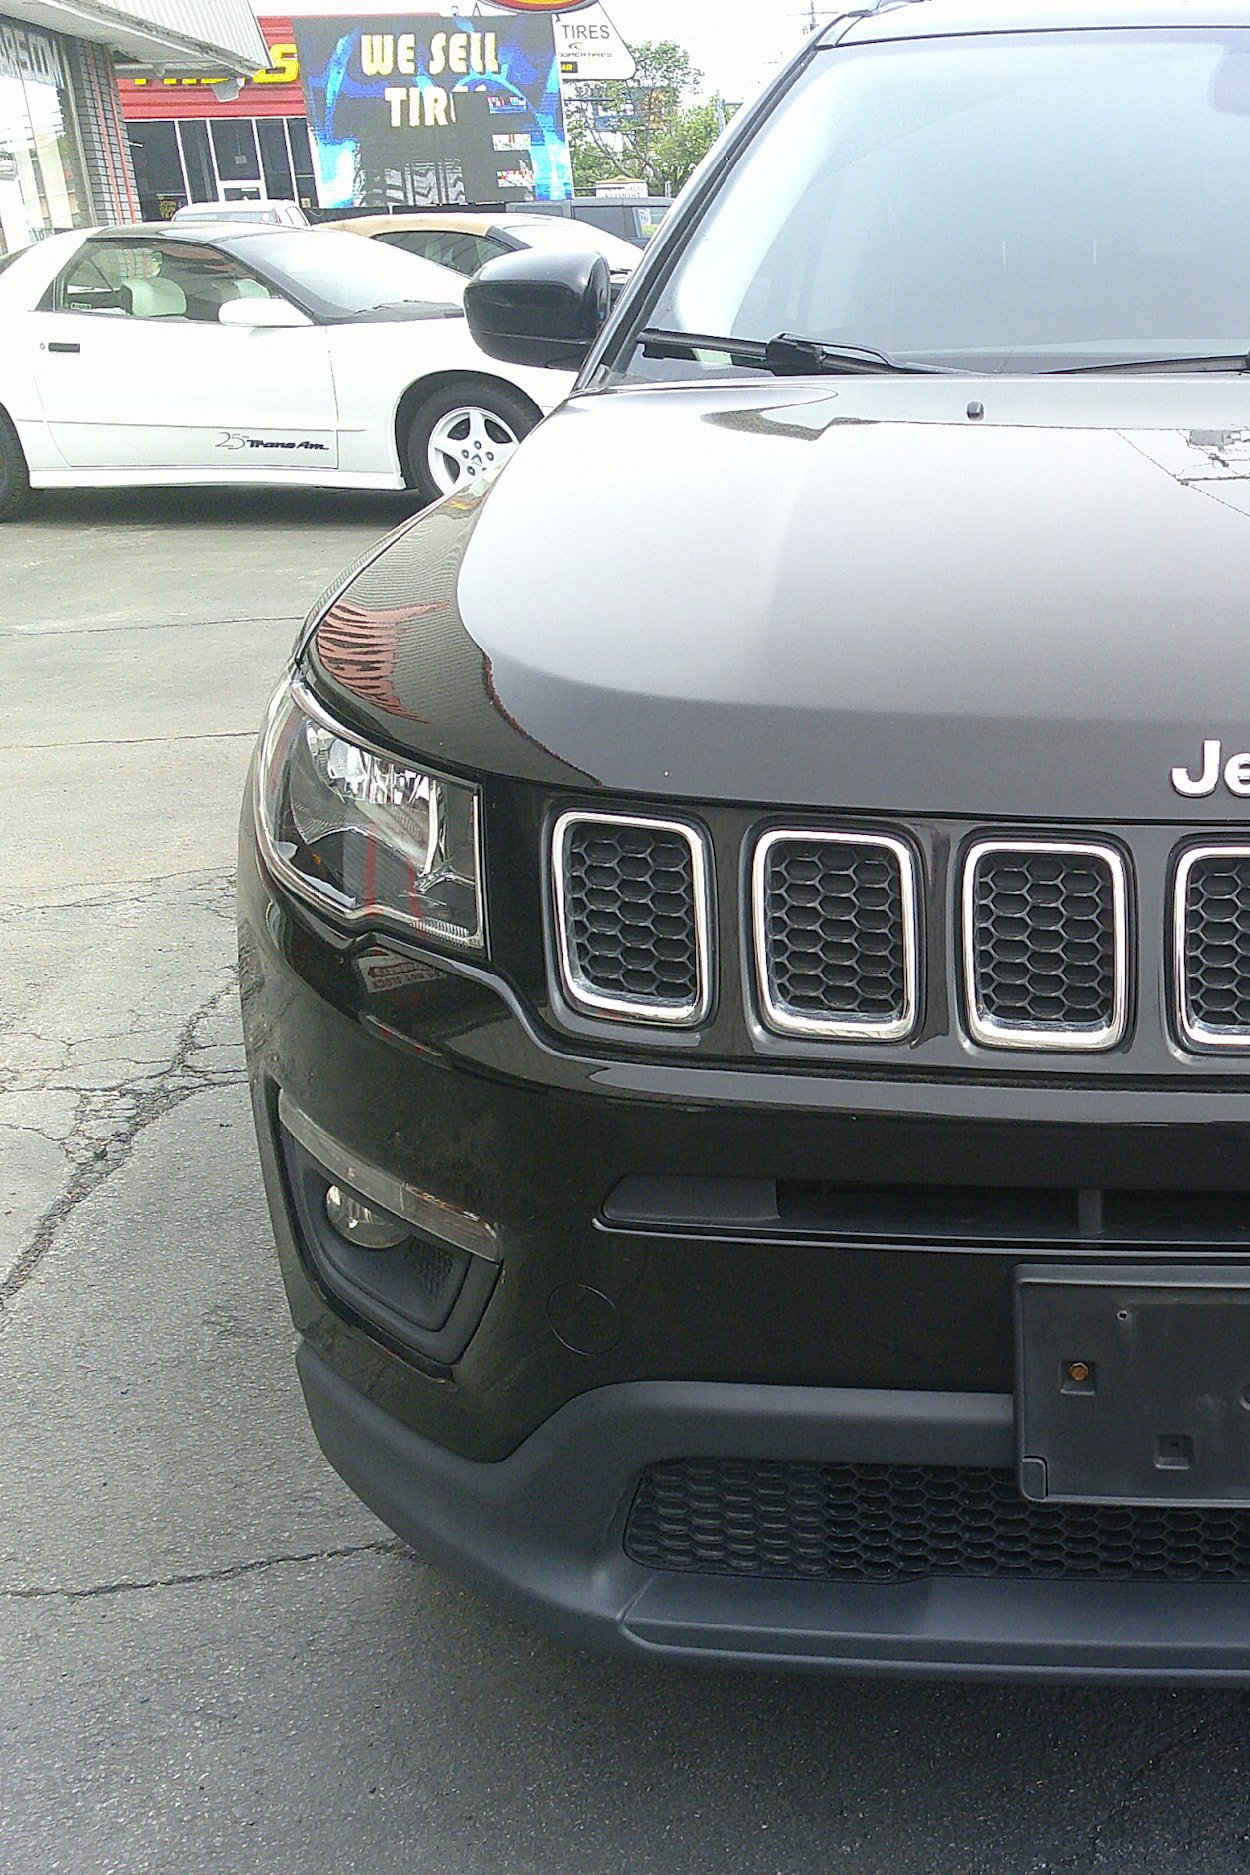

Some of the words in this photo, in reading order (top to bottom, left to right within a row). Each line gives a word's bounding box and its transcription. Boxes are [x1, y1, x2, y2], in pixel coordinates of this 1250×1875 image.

[361, 33, 416, 77] WE
[429, 31, 500, 76] SELL
[561, 25, 610, 40] TIRES
[384, 85, 488, 128] TIR
